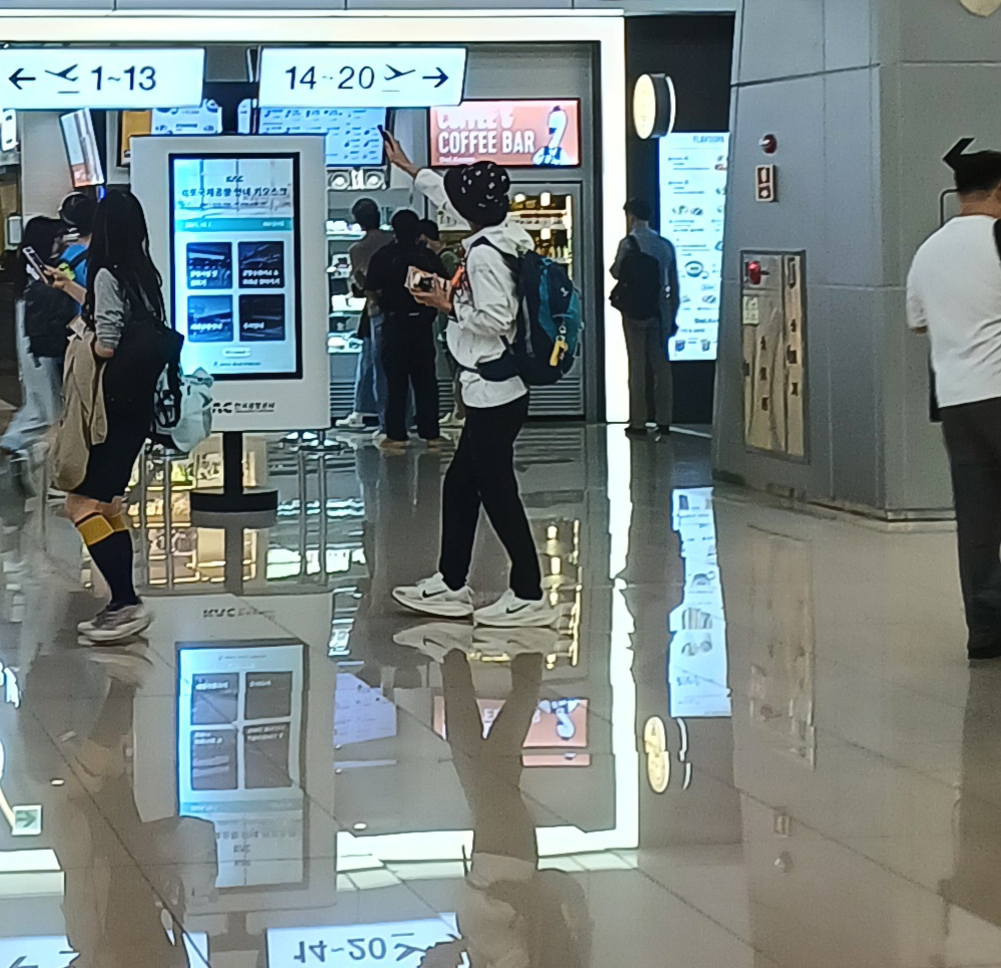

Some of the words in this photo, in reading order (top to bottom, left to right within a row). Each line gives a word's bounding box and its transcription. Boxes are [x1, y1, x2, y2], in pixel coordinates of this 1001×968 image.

[91, 65, 157, 91] 1~13
[438, 130, 498, 155] COFFEE
[501, 130, 536, 155] BAR
